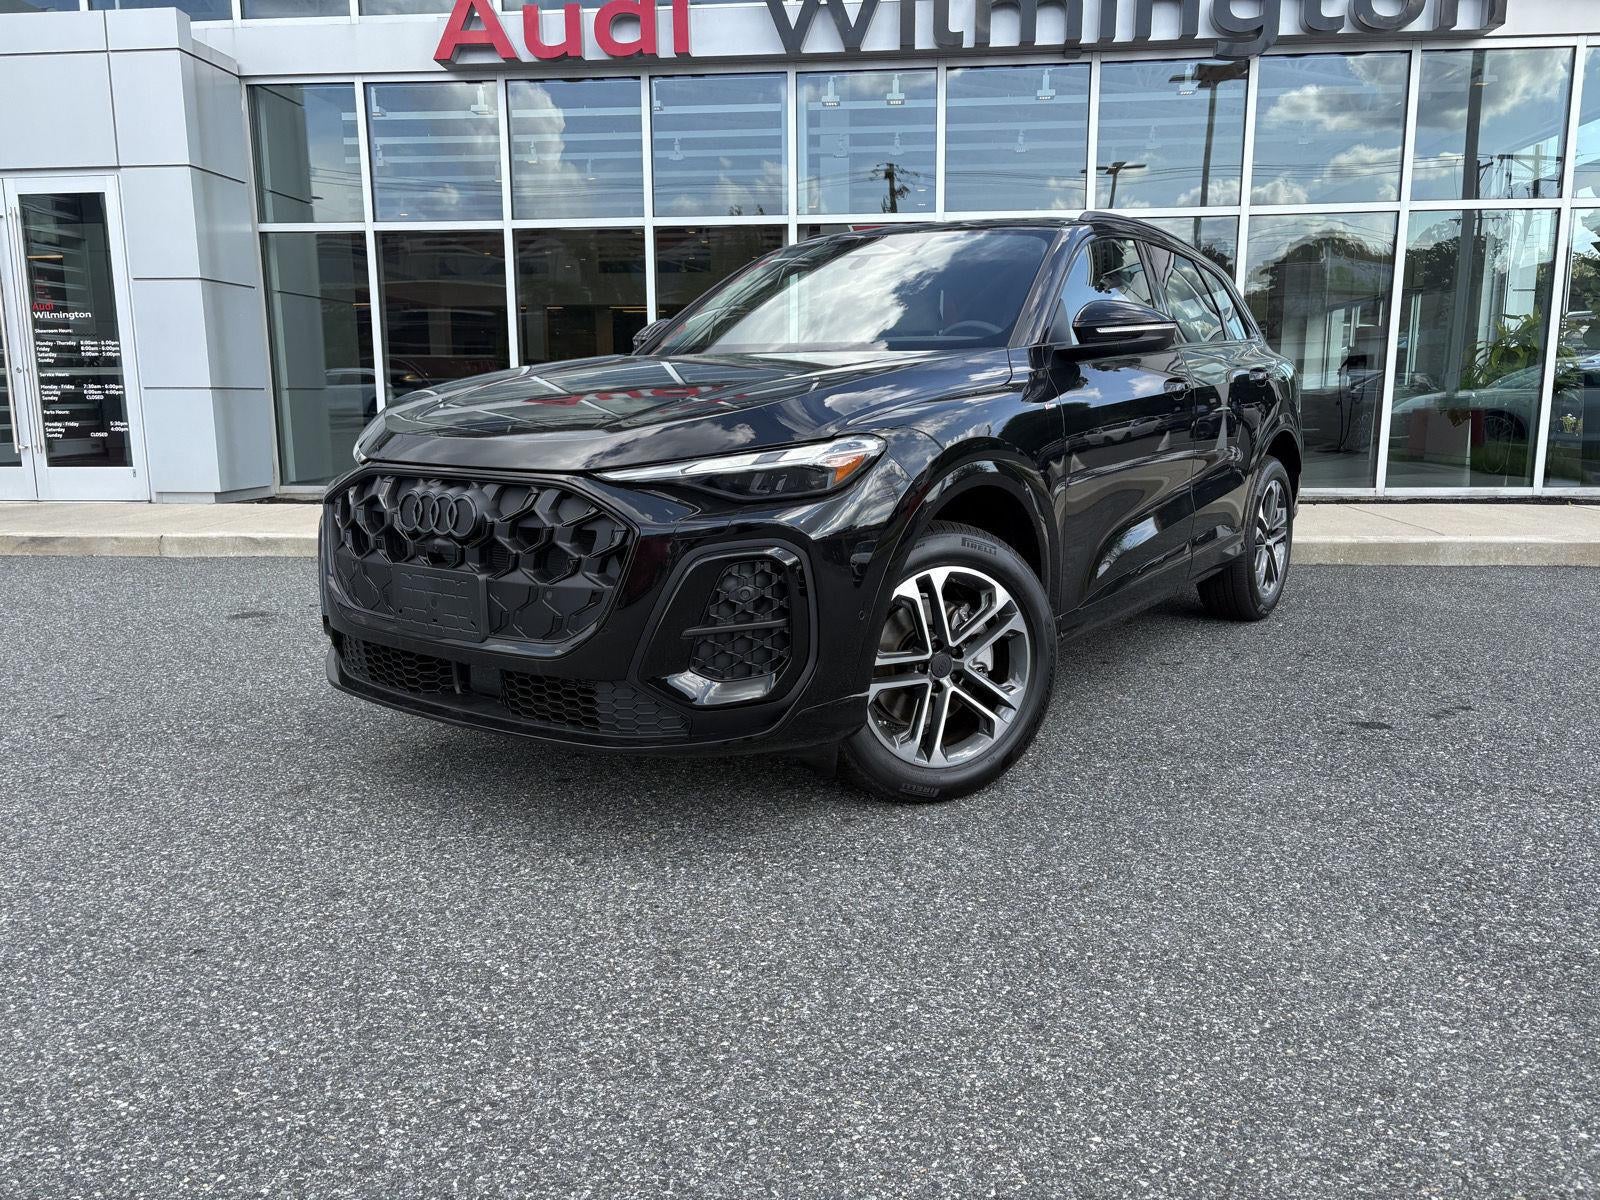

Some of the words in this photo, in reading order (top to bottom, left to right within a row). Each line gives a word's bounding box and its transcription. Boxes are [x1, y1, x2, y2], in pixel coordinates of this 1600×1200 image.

[433, 0, 692, 60] Audi
[33, 302, 54, 310] Audi
[33, 311, 92, 320] Wilmington
[961, 537, 997, 556] PIRELLI
